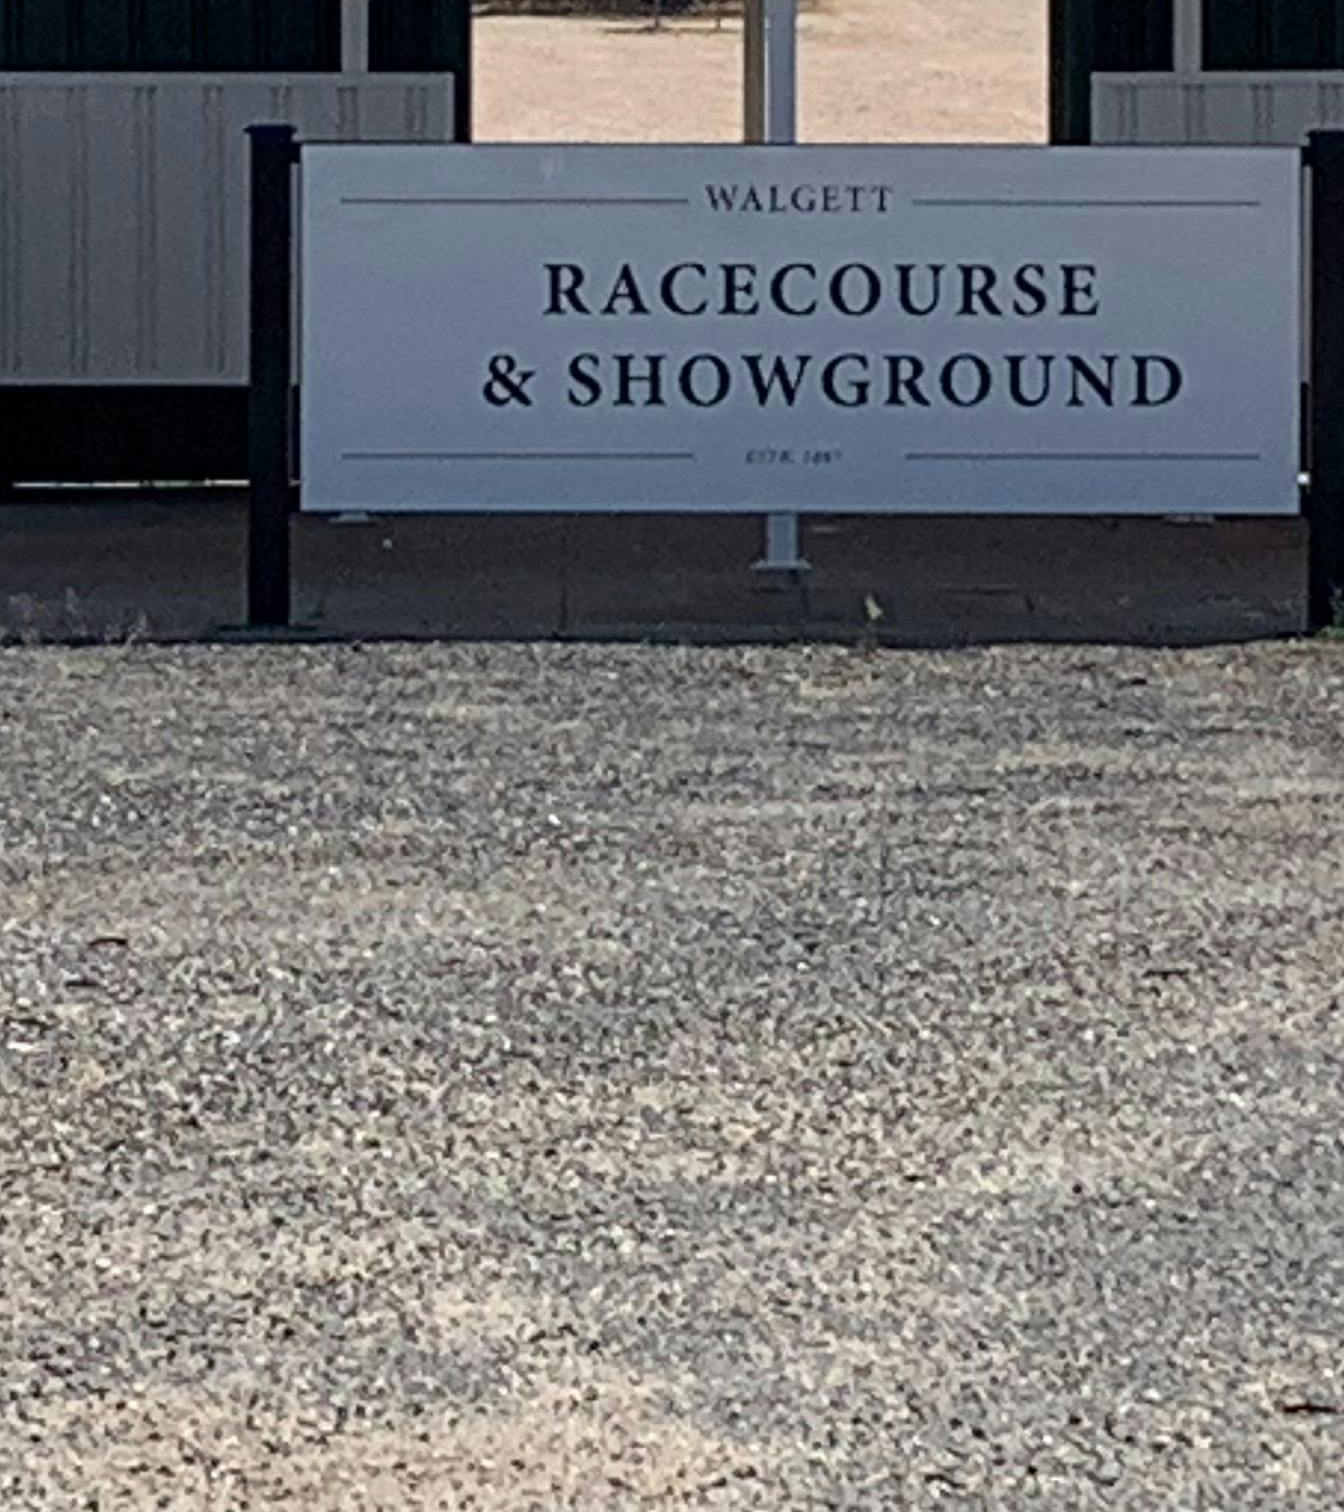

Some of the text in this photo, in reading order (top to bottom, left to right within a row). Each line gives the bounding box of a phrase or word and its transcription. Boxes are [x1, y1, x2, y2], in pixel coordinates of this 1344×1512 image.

[704, 185, 894, 214] WALGETT
[542, 262, 1100, 318] RACECOURSE
[481, 352, 1183, 409] & SHOWGROUND
